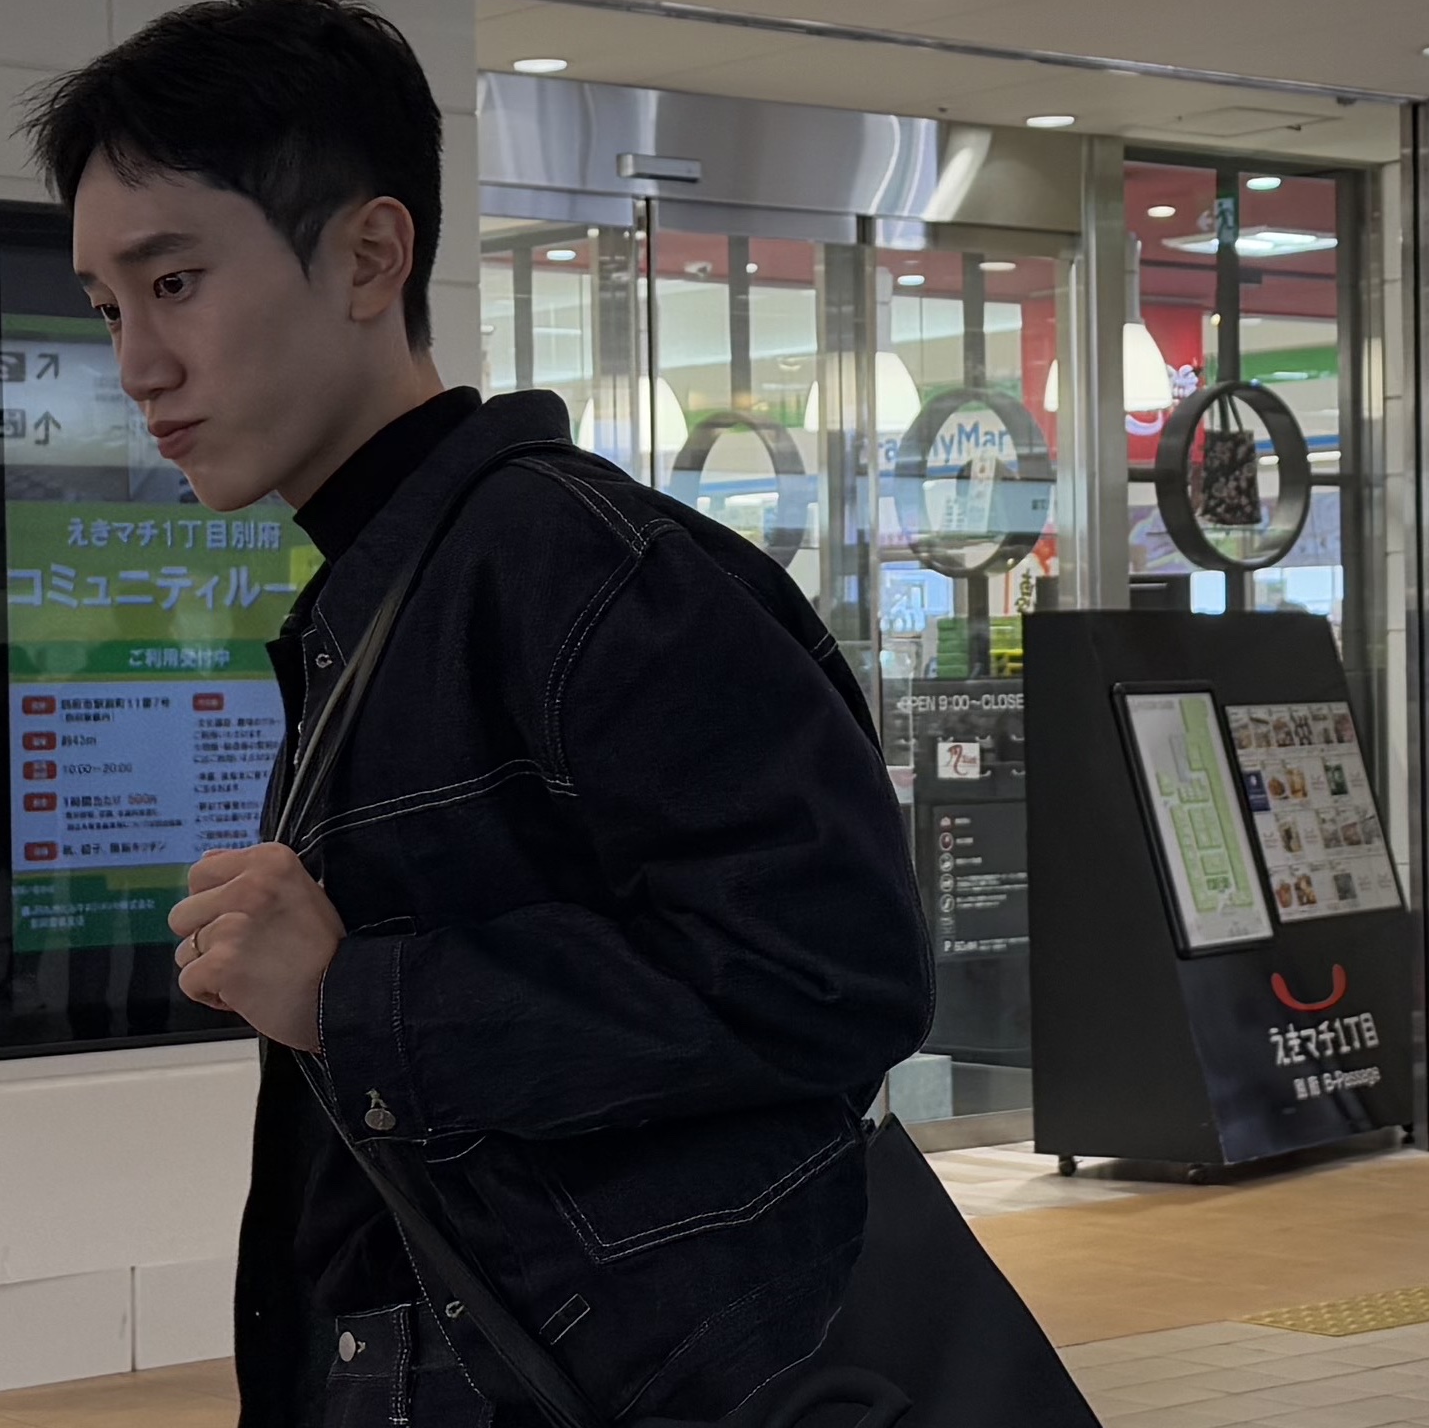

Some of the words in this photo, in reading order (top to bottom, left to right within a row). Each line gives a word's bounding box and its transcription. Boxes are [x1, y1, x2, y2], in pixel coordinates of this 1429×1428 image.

[68, 517, 282, 551] えきマチ1丁目別府
[8, 563, 297, 611] コミュニティルー
[129, 648, 230, 668] ご利用受付中
[1269, 1012, 1380, 1066] えきマチ1丁目
